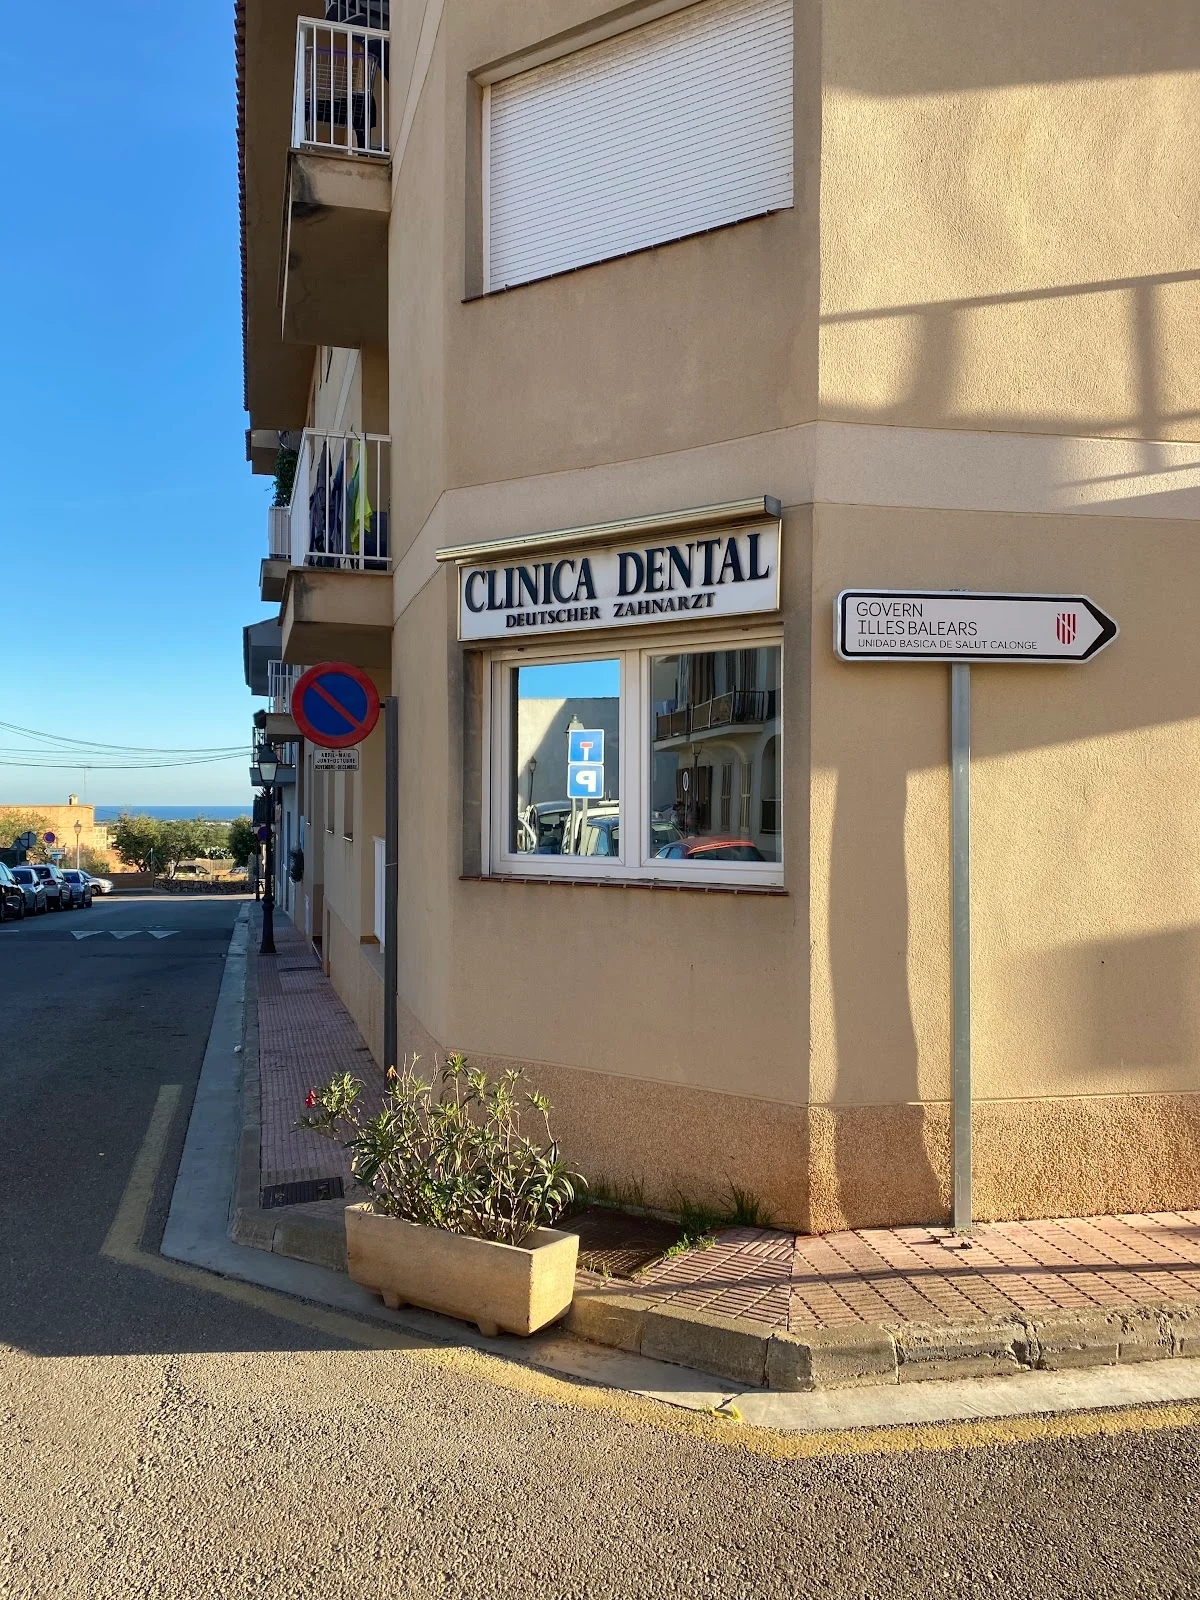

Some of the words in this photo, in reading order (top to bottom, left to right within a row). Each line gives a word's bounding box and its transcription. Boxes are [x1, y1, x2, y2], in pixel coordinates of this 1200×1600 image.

[464, 557, 597, 613] CLINICA
[616, 533, 770, 597] DENTAL
[505, 606, 601, 628] DEUTSCHER
[613, 592, 716, 618] ZAHNARZT
[856, 601, 923, 618] GOVERN
[857, 620, 905, 635] ILLES
[908, 621, 978, 636] BALEARS
[858, 639, 897, 648] UNIDAD
[899, 639, 937, 648] BASICA
[939, 640, 953, 649] DE
[955, 640, 988, 649] SALUT
[990, 640, 1038, 650] CALONGE
